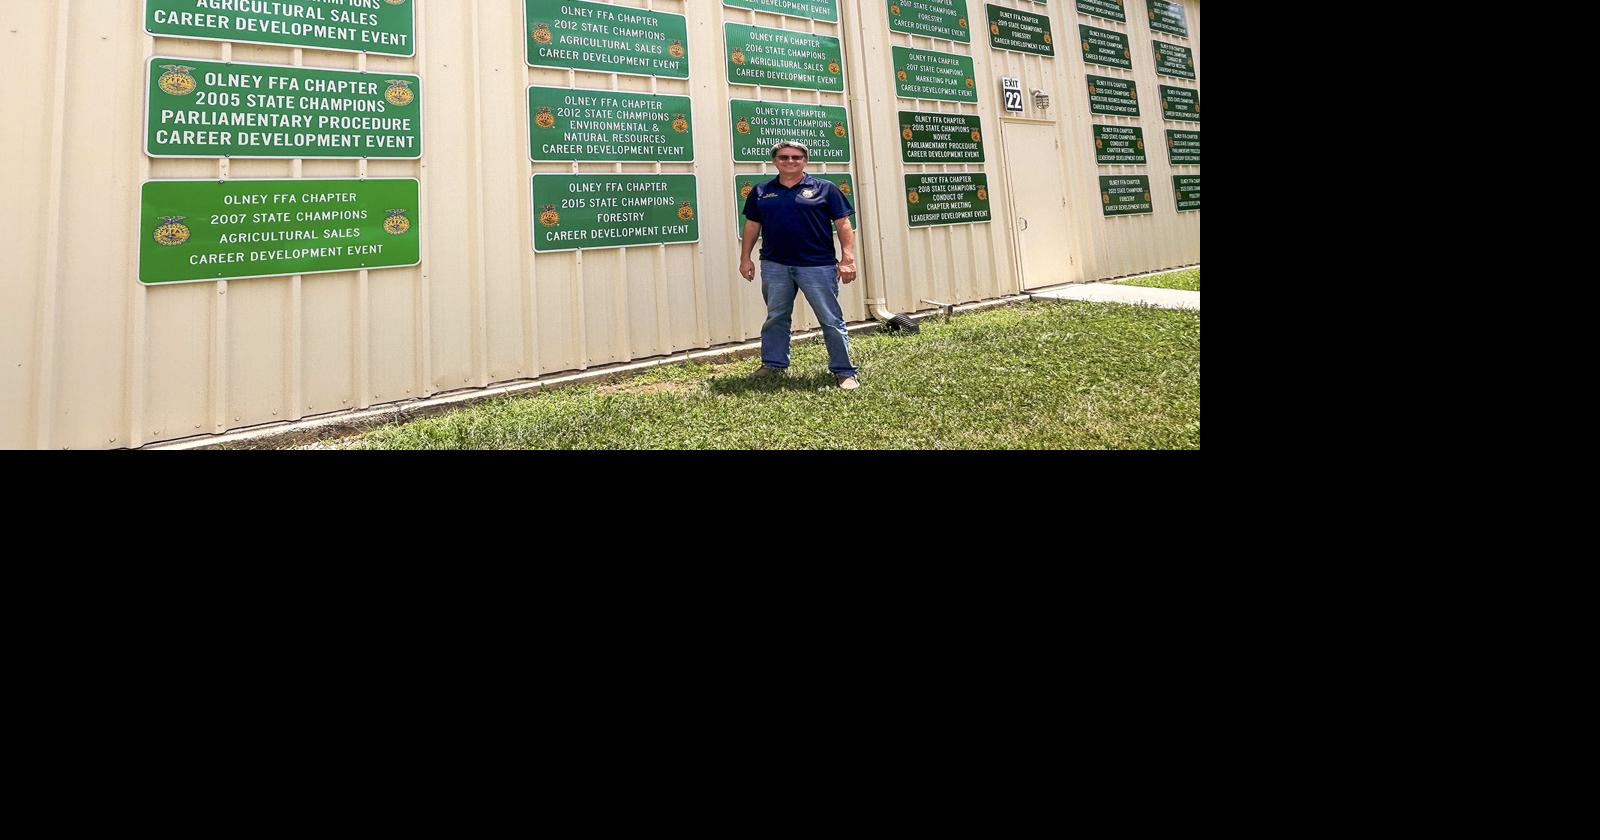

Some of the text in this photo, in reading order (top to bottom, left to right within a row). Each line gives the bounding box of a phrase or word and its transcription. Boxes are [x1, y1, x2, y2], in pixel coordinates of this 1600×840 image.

[196, 0, 325, 20] AGRICULTURAL
[331, 9, 378, 26] SALES
[761, 0, 830, 15] DEVELOPMENT EVENT
[914, 2, 928, 11] STATE
[929, 5, 957, 16] CHAMPIONS
[561, 6, 658, 27] OLNEY FFA CHAPTER
[918, 13, 942, 22] FORESTRY
[154, 10, 408, 46] CAREER DEVELOPMENT EVENT
[554, 19, 665, 41] 2012 STATE CHAMPIONS
[894, 19, 966, 37] CAREER DEVELOPMENT EVENT
[1020, 23, 1042, 33] CHAMPIONS
[750, 32, 820, 48] OLNEY FFA CHAPTER
[1011, 31, 1031, 39] FORESTRY
[560, 35, 662, 54] AGRICULTURAL SALES
[1011, 40, 1038, 49] DEVELOPMENT
[539, 48, 680, 69] CAREER DEVELOPMENT EVENT
[746, 44, 826, 60] 2016 STATE CHAMPIONS
[750, 57, 824, 71] AGRICULTURAL SALES
[909, 53, 926, 62] OLNEY
[938, 57, 959, 66] CHAPTER
[736, 68, 837, 84] CAREER DEVELOPMENT EVENT
[920, 65, 935, 73] STATE
[936, 67, 963, 76] CHAMPIONS
[205, 72, 378, 95] OLNEY FFA CHAPTER
[915, 75, 944, 84] MARKETING
[1004, 79, 1018, 88] EXIT
[901, 84, 972, 97] CAREER DEVELOPMENT EVENT
[195, 91, 385, 113] 2005 STATE CHAMPIONS
[565, 96, 662, 110] OLNEY FFA CHAPTER
[1006, 91, 1022, 109] 22
[557, 108, 669, 121] 2012 STATE CHAMPIONS
[756, 107, 826, 118] OLNEY FFA CHAPTER
[161, 110, 411, 131] PARLIAMENTARY PROCEDURE
[570, 121, 659, 132] ENVIRONMENTAL &
[751, 117, 832, 128] 2016 STATE CHAMPIONS
[760, 128, 817, 137] ENVIRONMENTAL
[941, 125, 969, 133] CHAMPIONS
[156, 130, 414, 148] CAREER DEVELOPMENT EVENT
[564, 133, 666, 143] NATURAL RESOURCES
[756, 137, 787, 146] NATURA
[542, 144, 684, 155] CAREER DEVELOPMENT EVENT
[742, 148, 770, 156] CAREER
[824, 149, 843, 157] EVENT
[949, 142, 978, 150] PROCEDURE
[569, 183, 667, 193] OLNEY FFA CHAPTER
[224, 193, 357, 205] OLNEY FFA CHAPTER
[561, 197, 674, 209] 2015 STATE CHAMPIONS
[210, 210, 368, 225] 2007 STATE CHAMPIONS
[597, 212, 645, 222] FORESTRY
[911, 214, 940, 222] LEADERSHIP
[941, 211, 973, 220] DEVELOPMENT
[219, 228, 360, 244] AGRICULTURAL SALES
[546, 225, 689, 241] CAREER DEVELOPMENT EVENT
[190, 244, 383, 265] CAREER DEVELOPMENT EVENT
